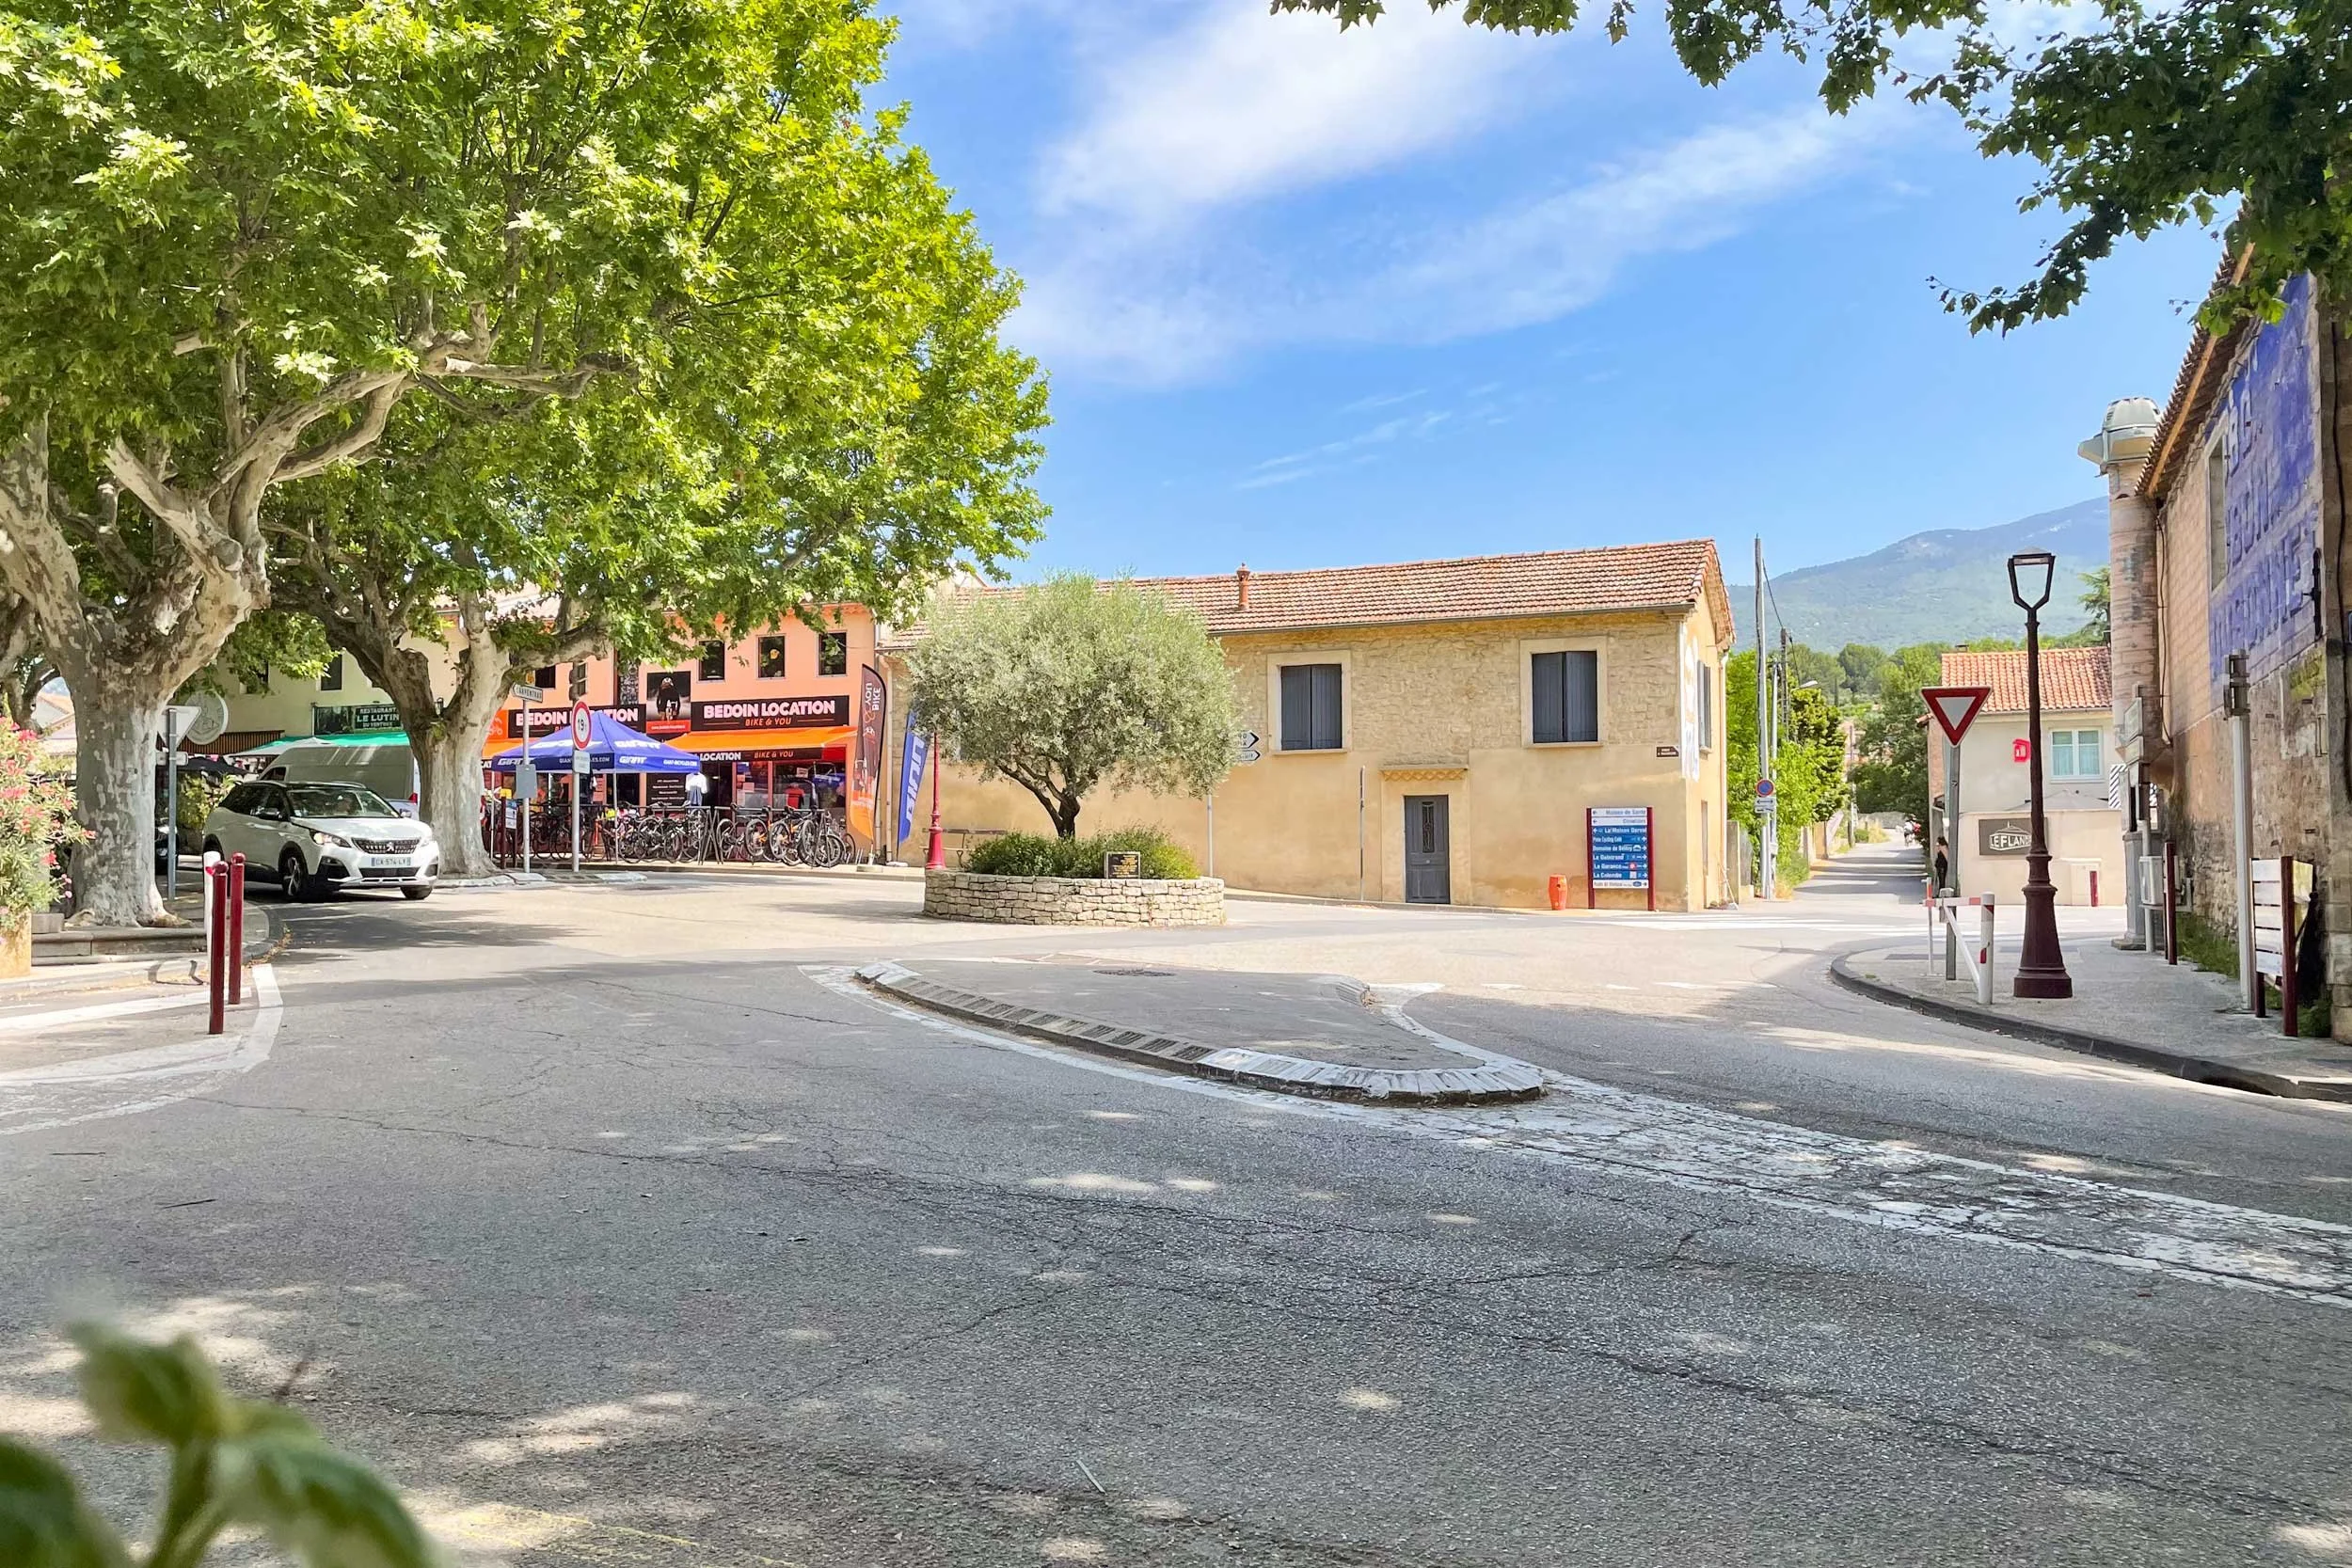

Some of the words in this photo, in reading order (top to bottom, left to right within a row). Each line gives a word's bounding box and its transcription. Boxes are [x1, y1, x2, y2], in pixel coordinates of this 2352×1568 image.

[704, 704, 759, 719] BEDOIN
[761, 700, 835, 717] LOCATION
[371, 714, 399, 722] LUTIN
[516, 711, 567, 726] BEDOIN
[745, 718, 763, 726] BIKE
[766, 717, 771, 725] &
[774, 717, 791, 725] YOU
[619, 756, 647, 765] GIANT
[699, 752, 741, 761] LOCATION
